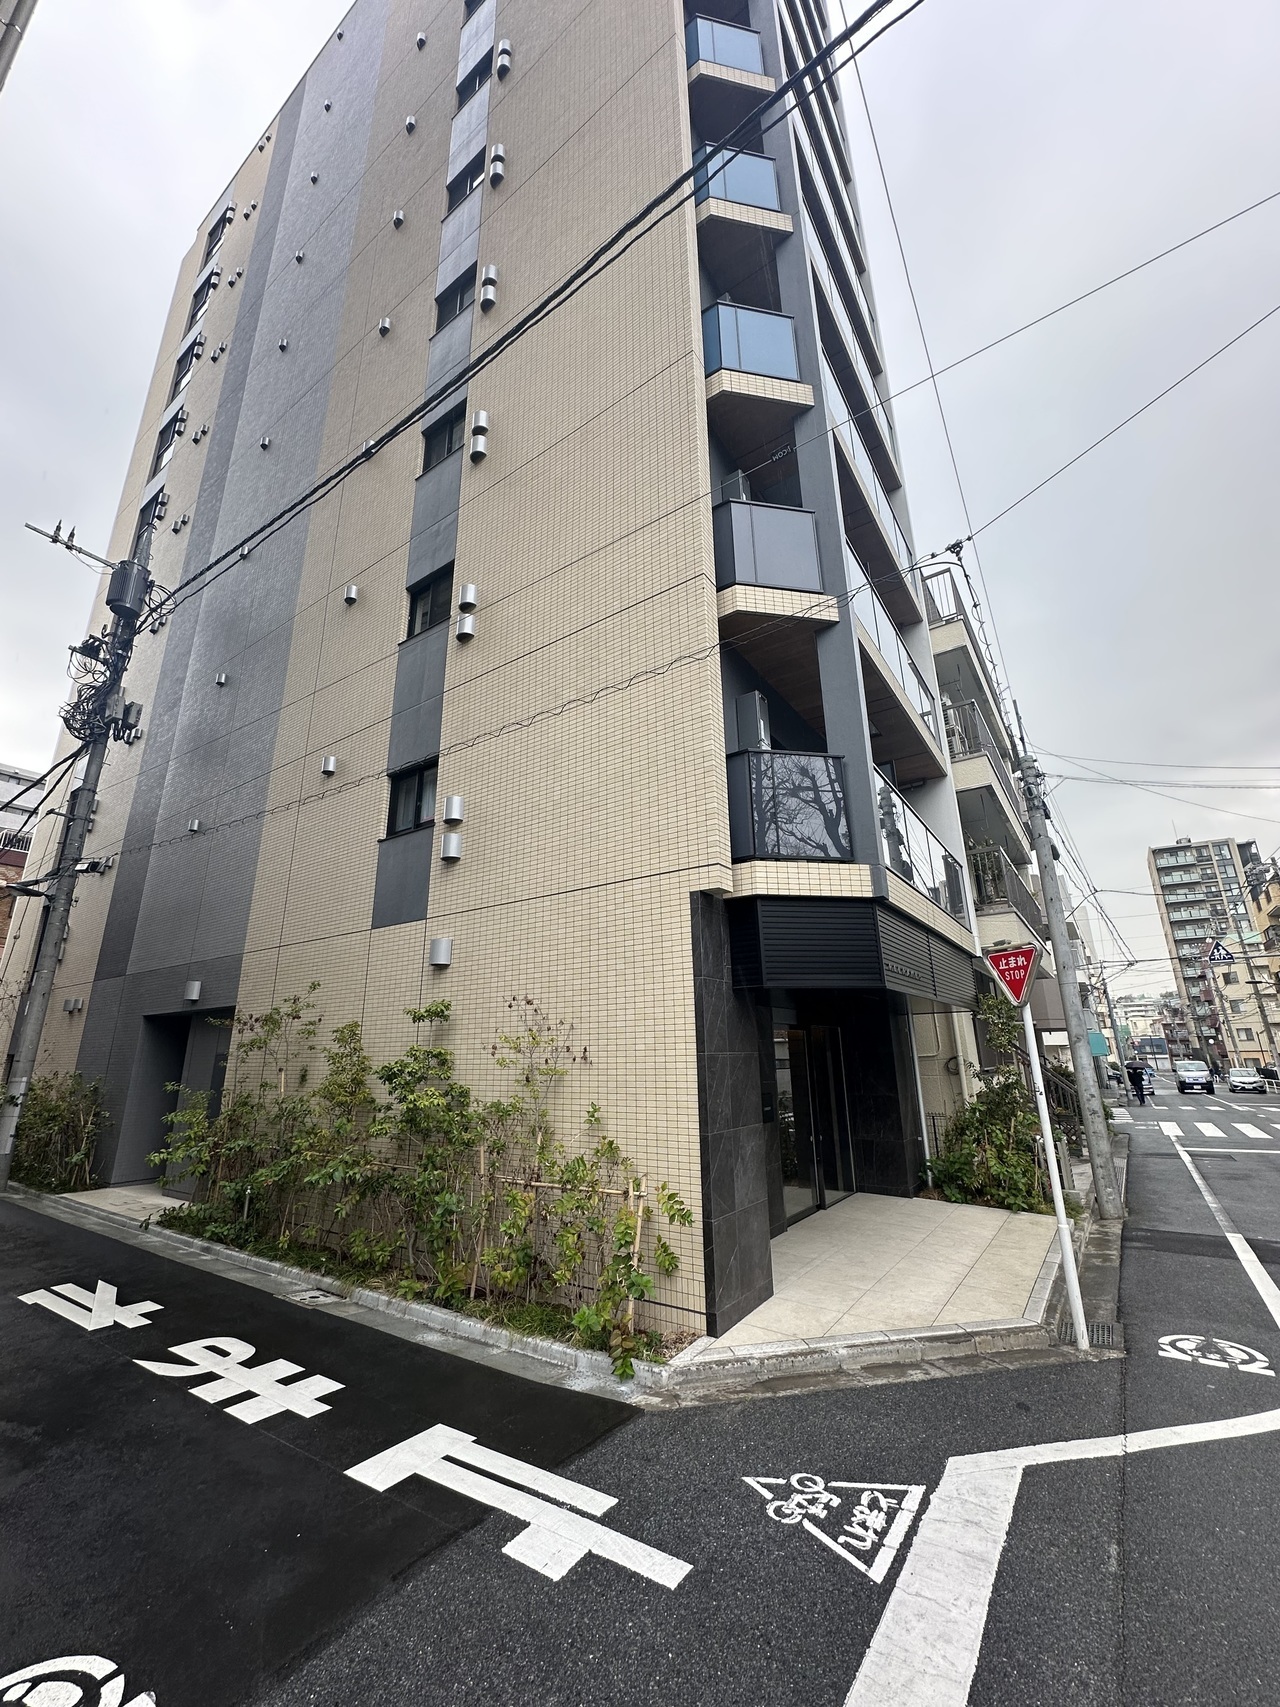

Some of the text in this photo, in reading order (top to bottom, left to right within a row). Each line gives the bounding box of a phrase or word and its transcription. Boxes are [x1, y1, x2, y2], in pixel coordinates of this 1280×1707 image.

[999, 955, 1027, 970] 止まれ
[1005, 969, 1025, 981] STOP
[837, 1490, 900, 1550] とまれ
